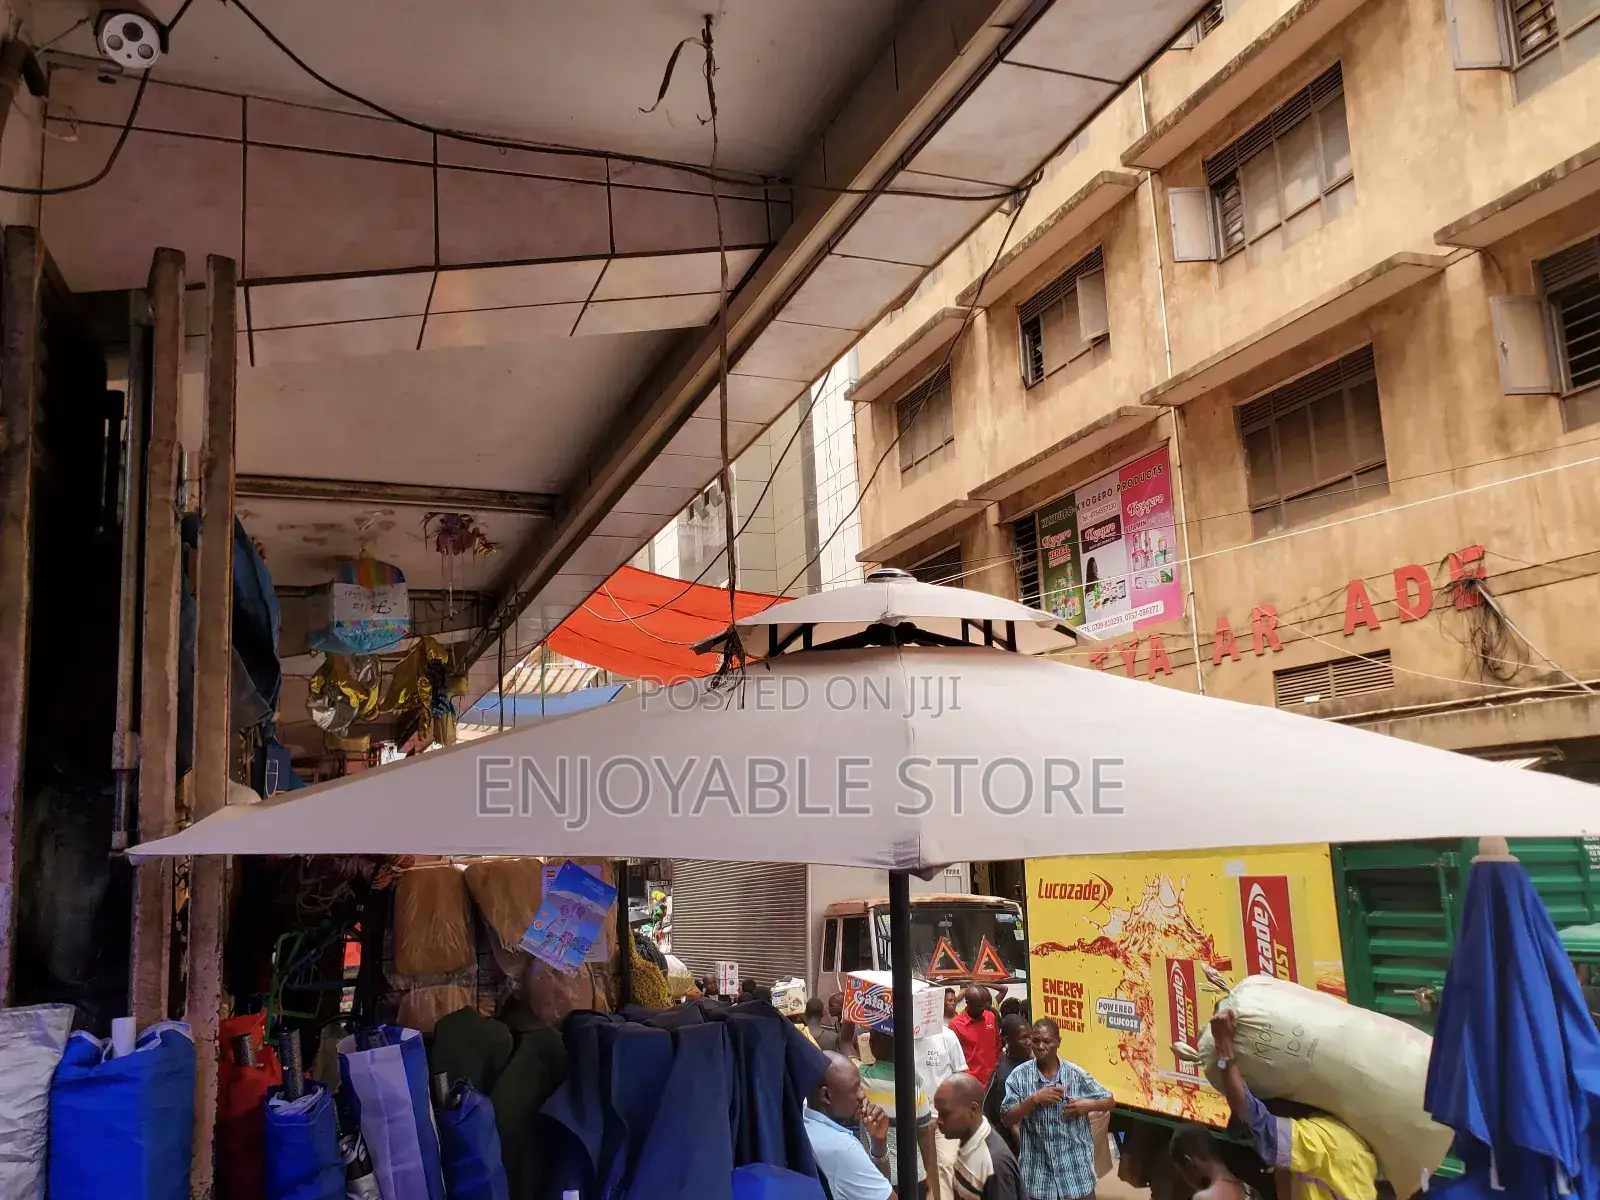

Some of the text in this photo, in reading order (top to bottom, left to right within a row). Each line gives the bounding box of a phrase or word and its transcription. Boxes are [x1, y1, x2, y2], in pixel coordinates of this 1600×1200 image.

[1116, 464, 1163, 493] PRODUCTS
[1038, 877, 1101, 901] Lucozade
[1273, 939, 1290, 981] OST
[1042, 977, 1084, 999] ENERGY
[1043, 995, 1084, 1020] TO GET
[1098, 1001, 1133, 1014] POWERED
[1173, 974, 1187, 1043] ucozade
[1184, 994, 1196, 1038] BOOST
[1108, 1016, 1138, 1028] GLUCOSE
